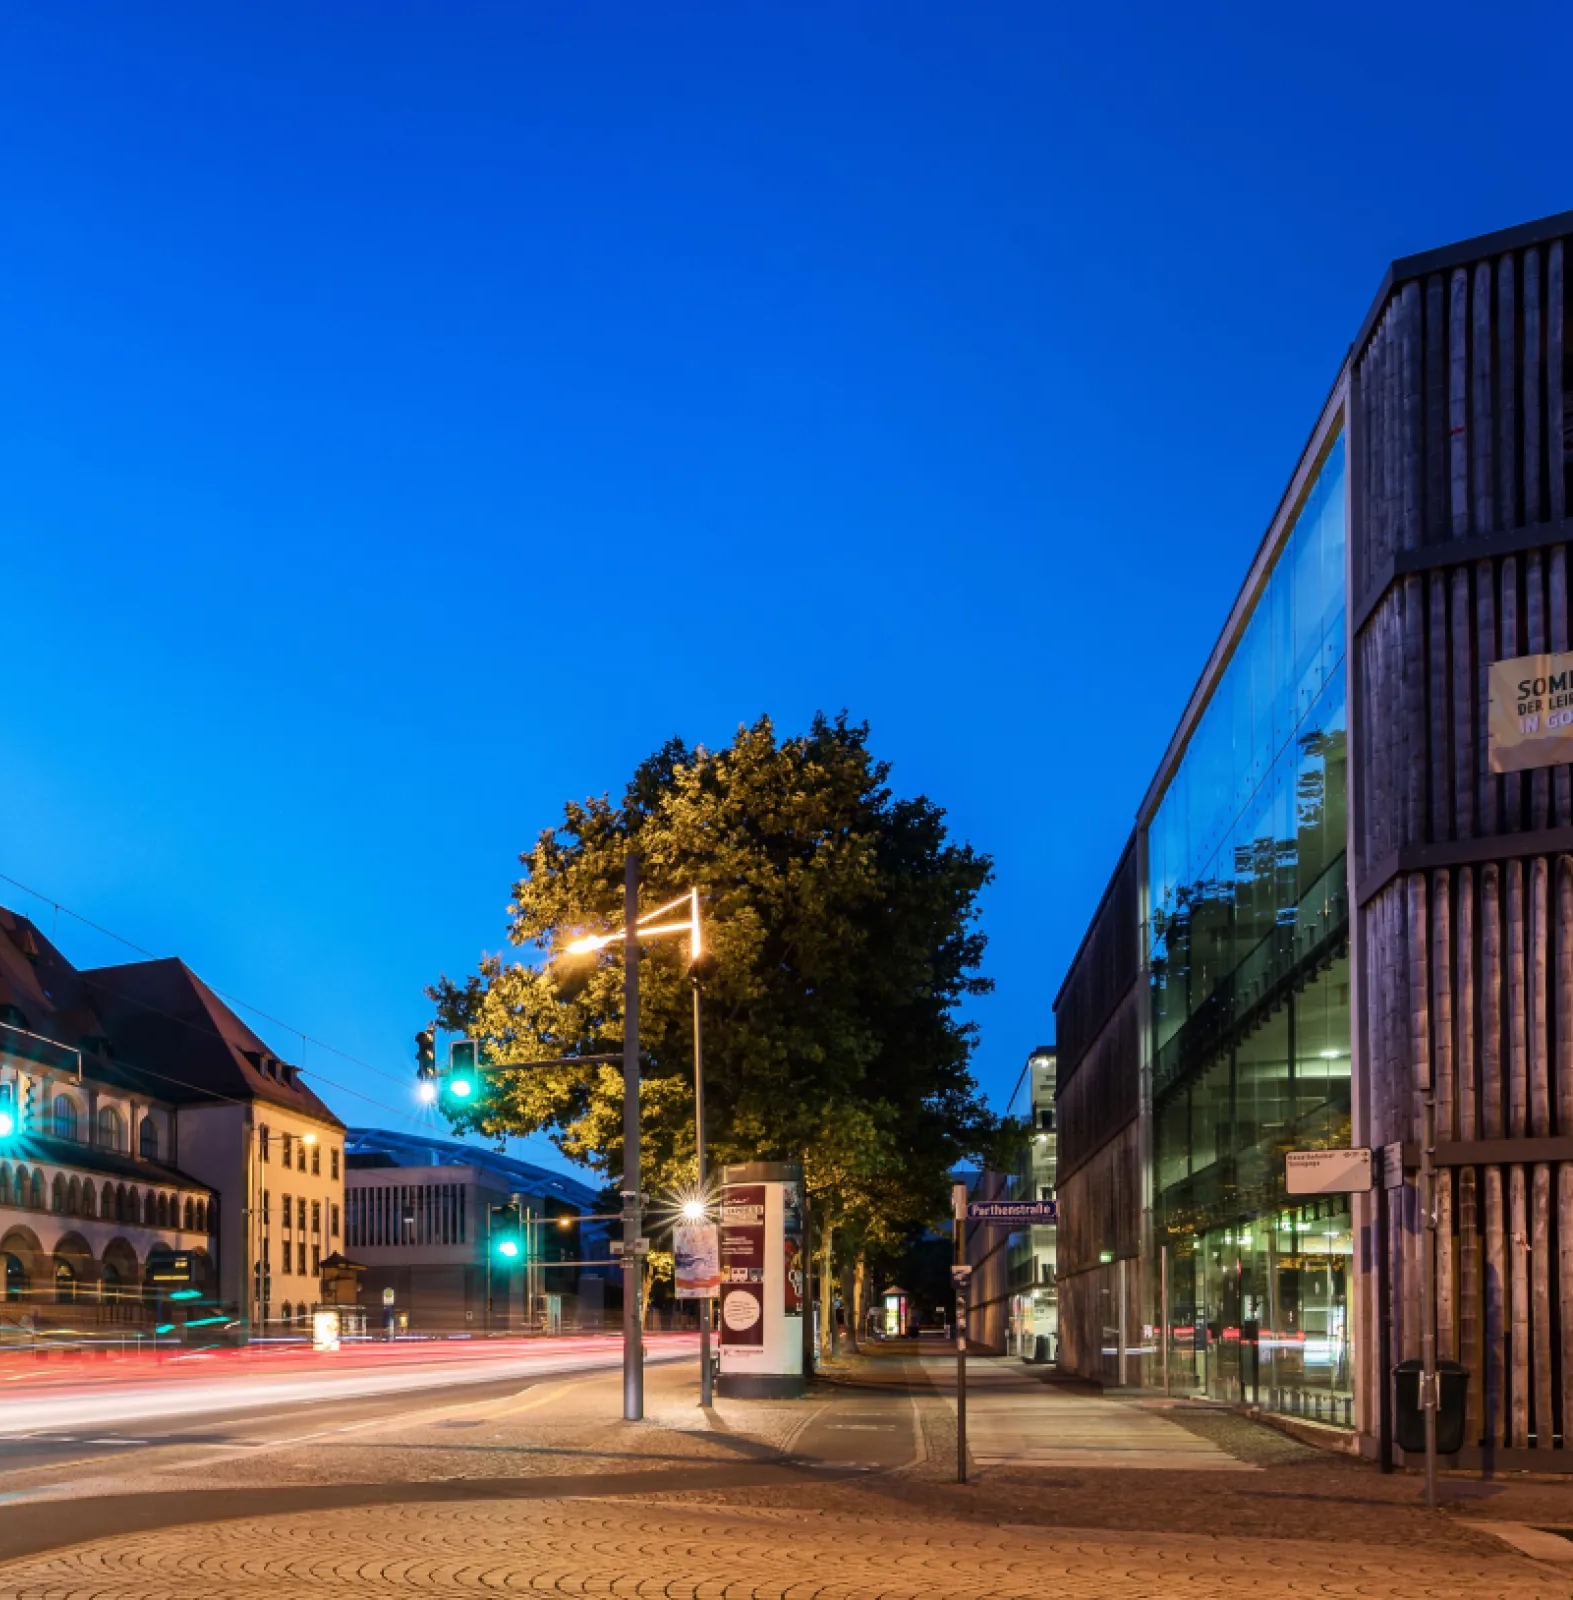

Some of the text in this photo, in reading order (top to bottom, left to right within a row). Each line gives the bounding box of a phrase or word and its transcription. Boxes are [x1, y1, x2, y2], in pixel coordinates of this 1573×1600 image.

[1518, 670, 1573, 701] SOM
[1518, 699, 1543, 716] DER
[1519, 715, 1540, 734] IN
